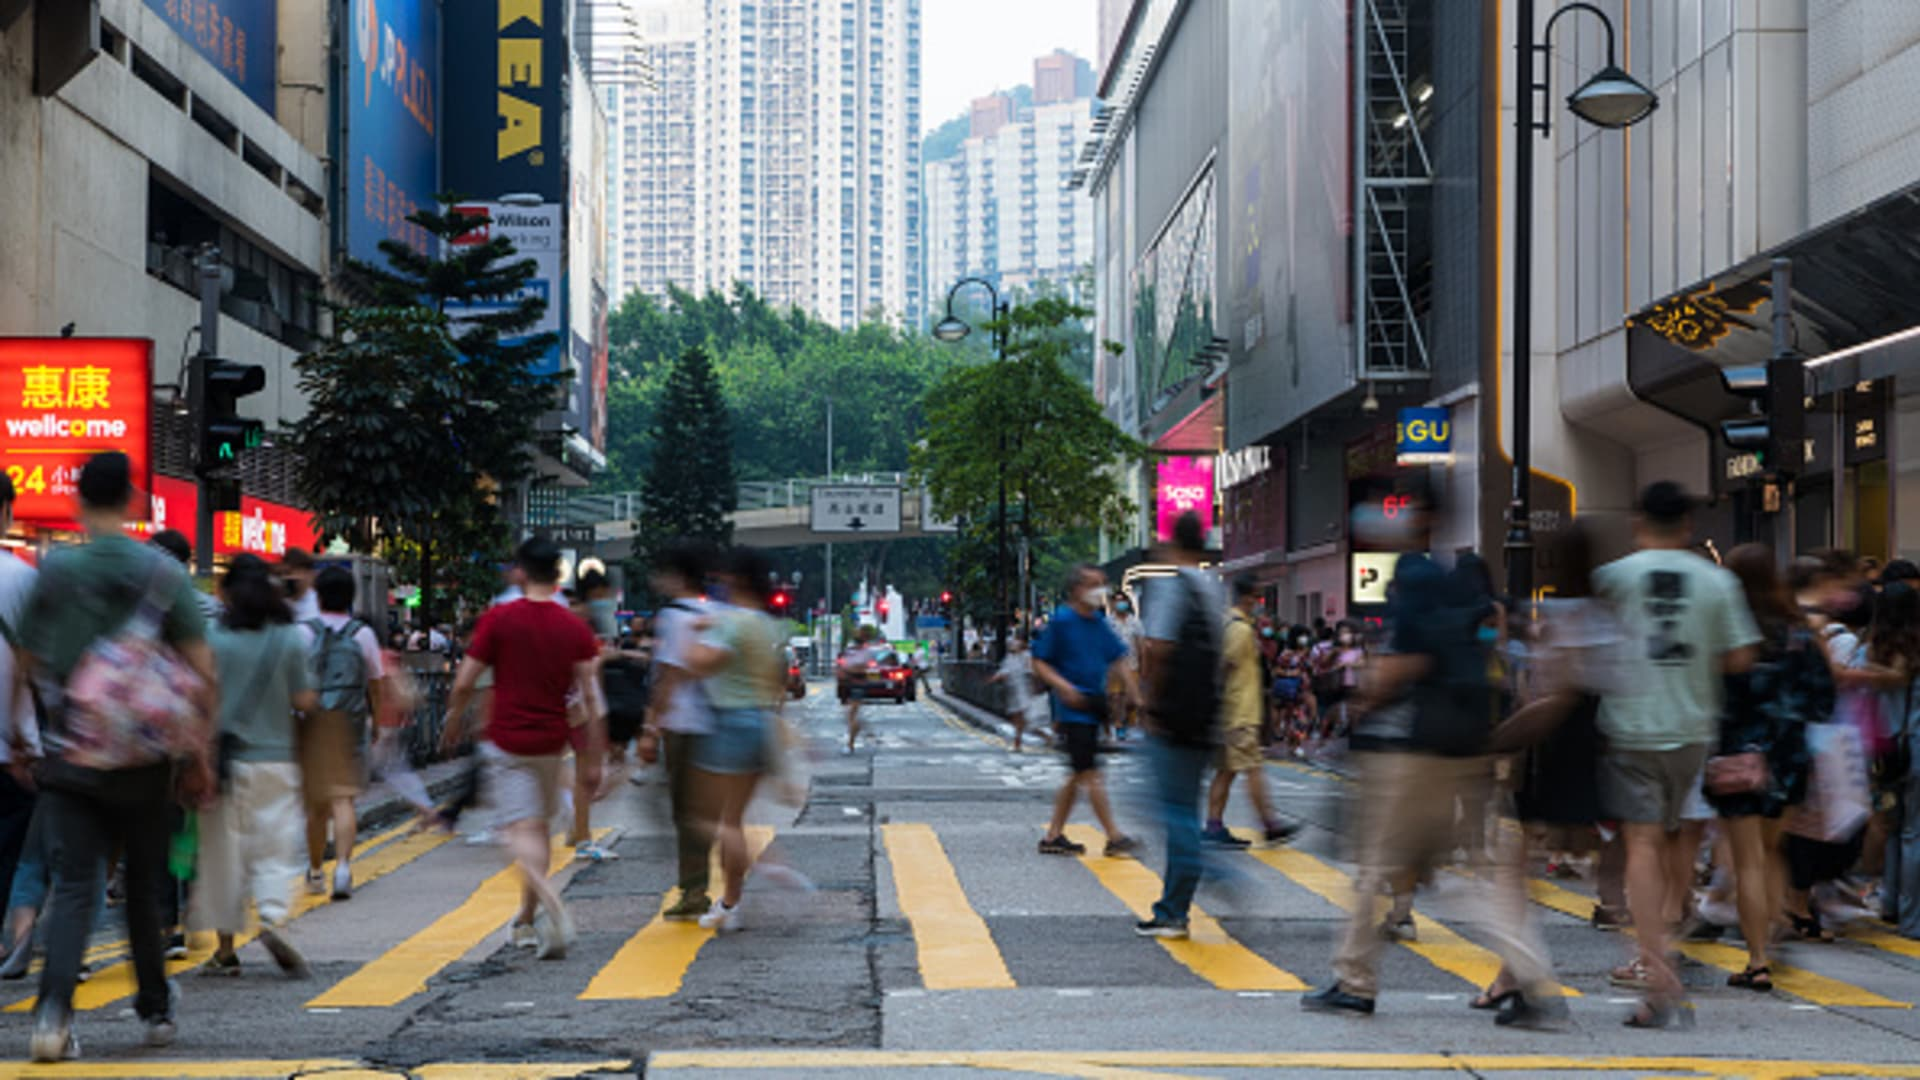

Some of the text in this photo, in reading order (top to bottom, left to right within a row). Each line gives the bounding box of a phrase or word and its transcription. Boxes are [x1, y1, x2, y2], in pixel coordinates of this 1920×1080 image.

[497, 212, 550, 227] Wilson
[21, 364, 111, 409] 惠康
[6, 414, 126, 437] wellcome
[6, 465, 46, 495] 24
